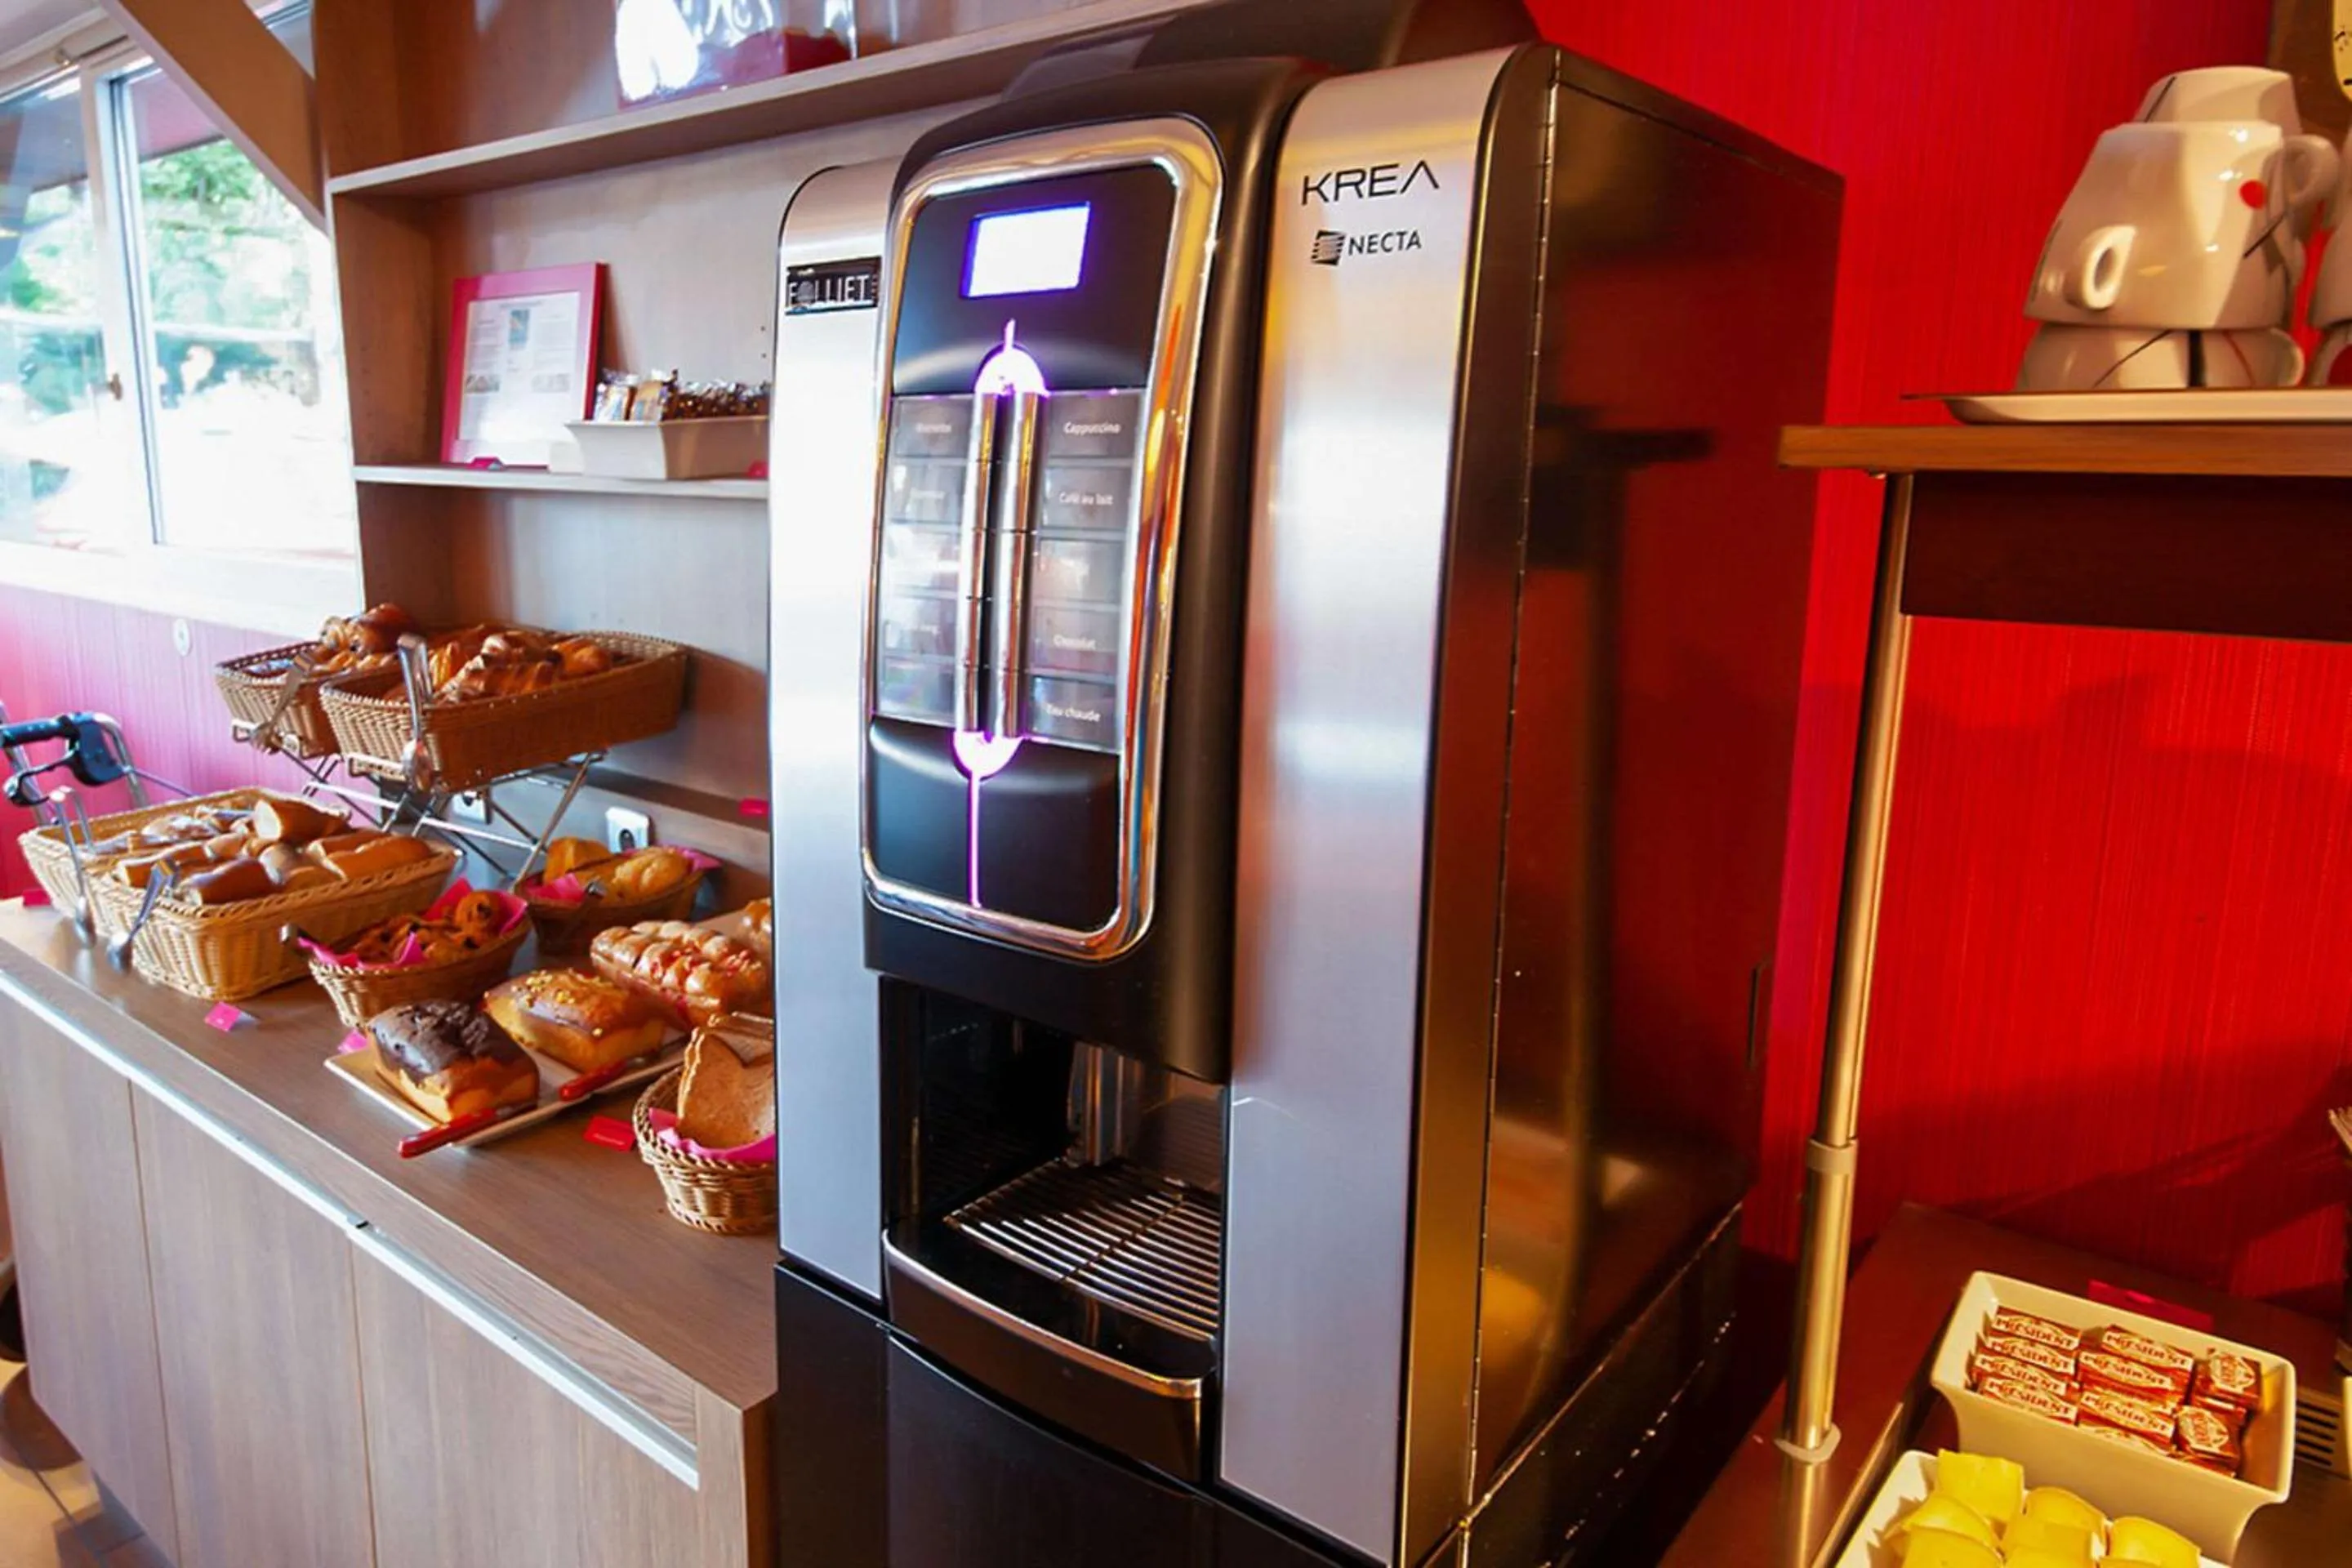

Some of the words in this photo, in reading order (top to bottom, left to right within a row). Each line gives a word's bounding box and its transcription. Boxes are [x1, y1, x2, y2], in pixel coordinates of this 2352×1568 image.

[1301, 160, 1441, 206] KREA
[1348, 230, 1423, 256] NECTA
[1062, 421, 1122, 436] Cappuccino
